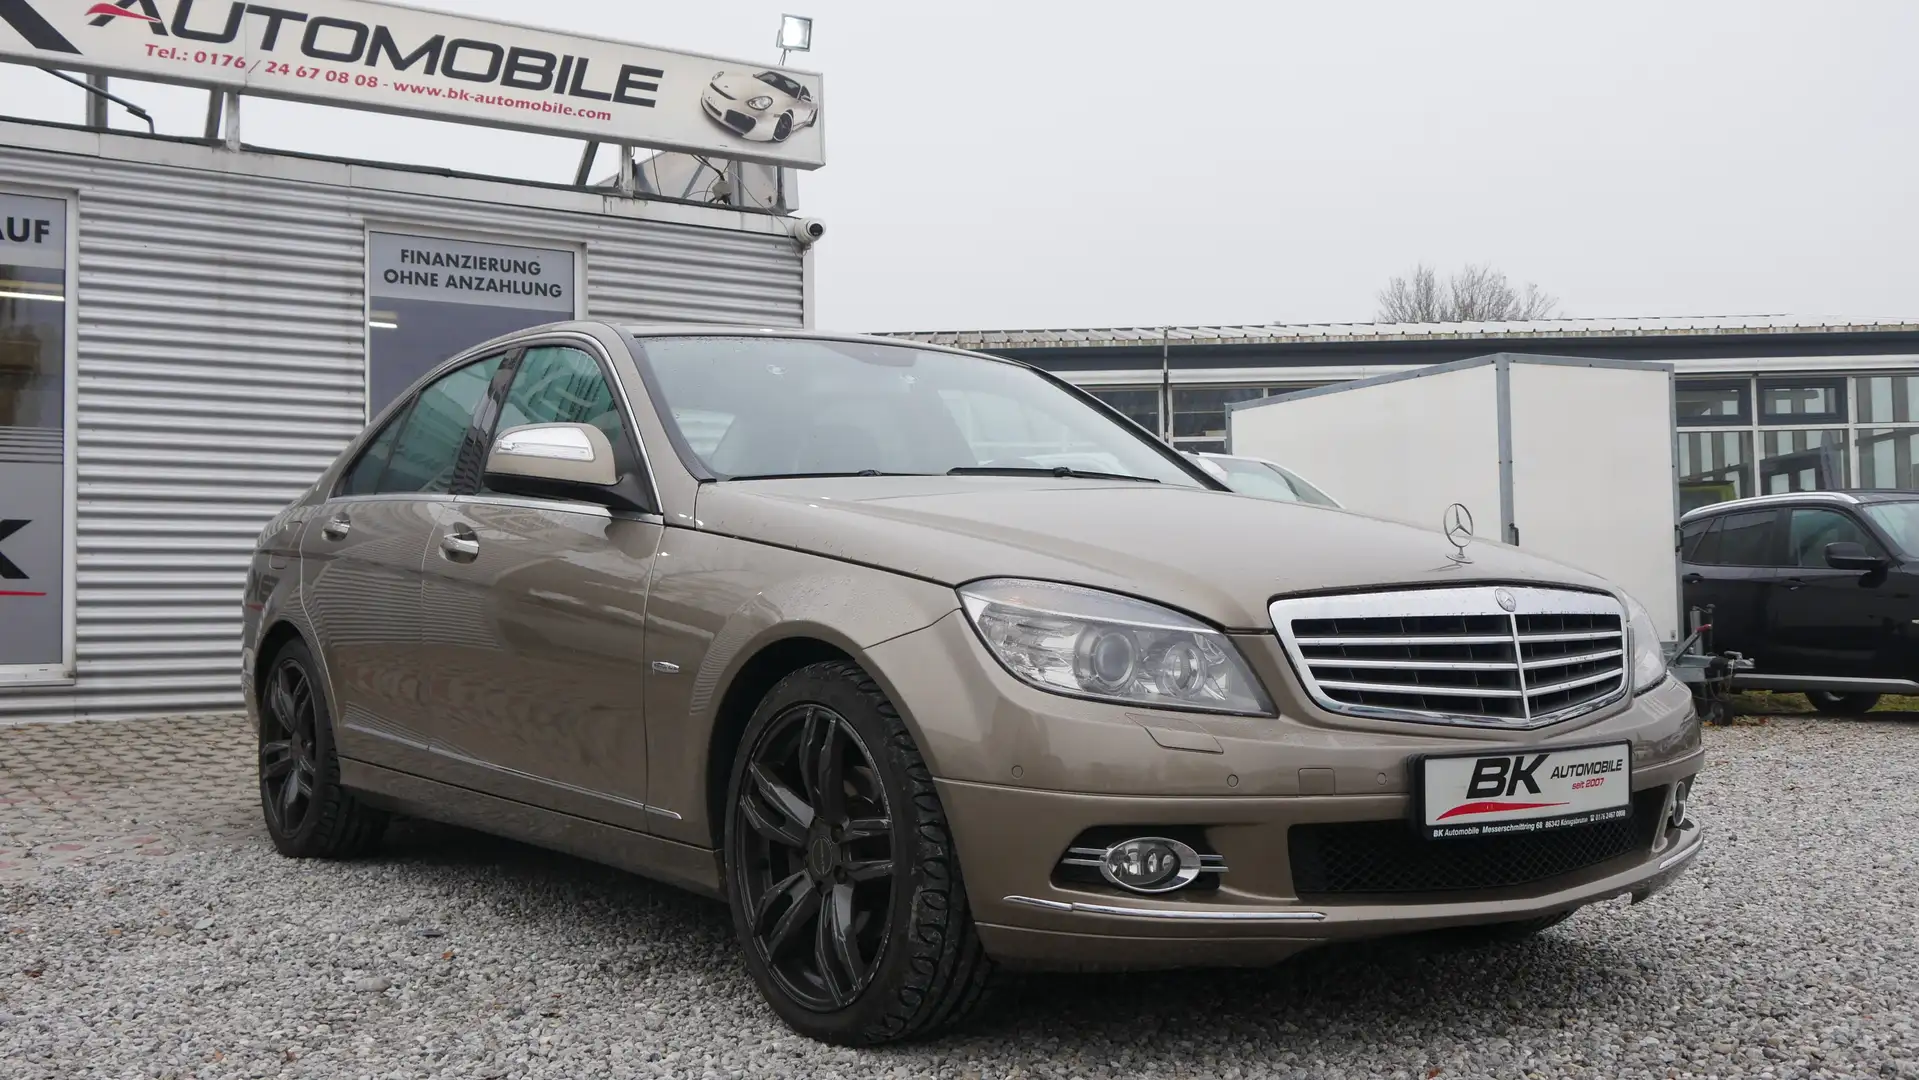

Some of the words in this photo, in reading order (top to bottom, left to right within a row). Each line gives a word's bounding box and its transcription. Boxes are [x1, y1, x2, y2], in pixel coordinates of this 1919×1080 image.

[86, 0, 664, 108] AUTOMOBILE
[145, 43, 188, 61] Tel.:
[194, 51, 246, 69] 0176
[265, 61, 290, 75] 24
[295, 65, 320, 79] 67
[325, 70, 349, 84] 08
[354, 74, 378, 88] 08
[393, 80, 612, 121] www.bk-automobile.com
[0, 216, 50, 244] UF
[401, 249, 541, 276] FINANZIERUNG
[384, 268, 439, 288] OHNE
[445, 274, 562, 298] ANZAHLUNG
[1466, 754, 1550, 799] BK
[1550, 758, 1624, 780] AUTOMOBILE
[1571, 780, 1585, 790] seit
[1586, 777, 1605, 789] 2007
[1433, 829, 1444, 838] BK
[1444, 827, 1480, 837] Automobile
[1482, 822, 1535, 834] Messerschmittring
